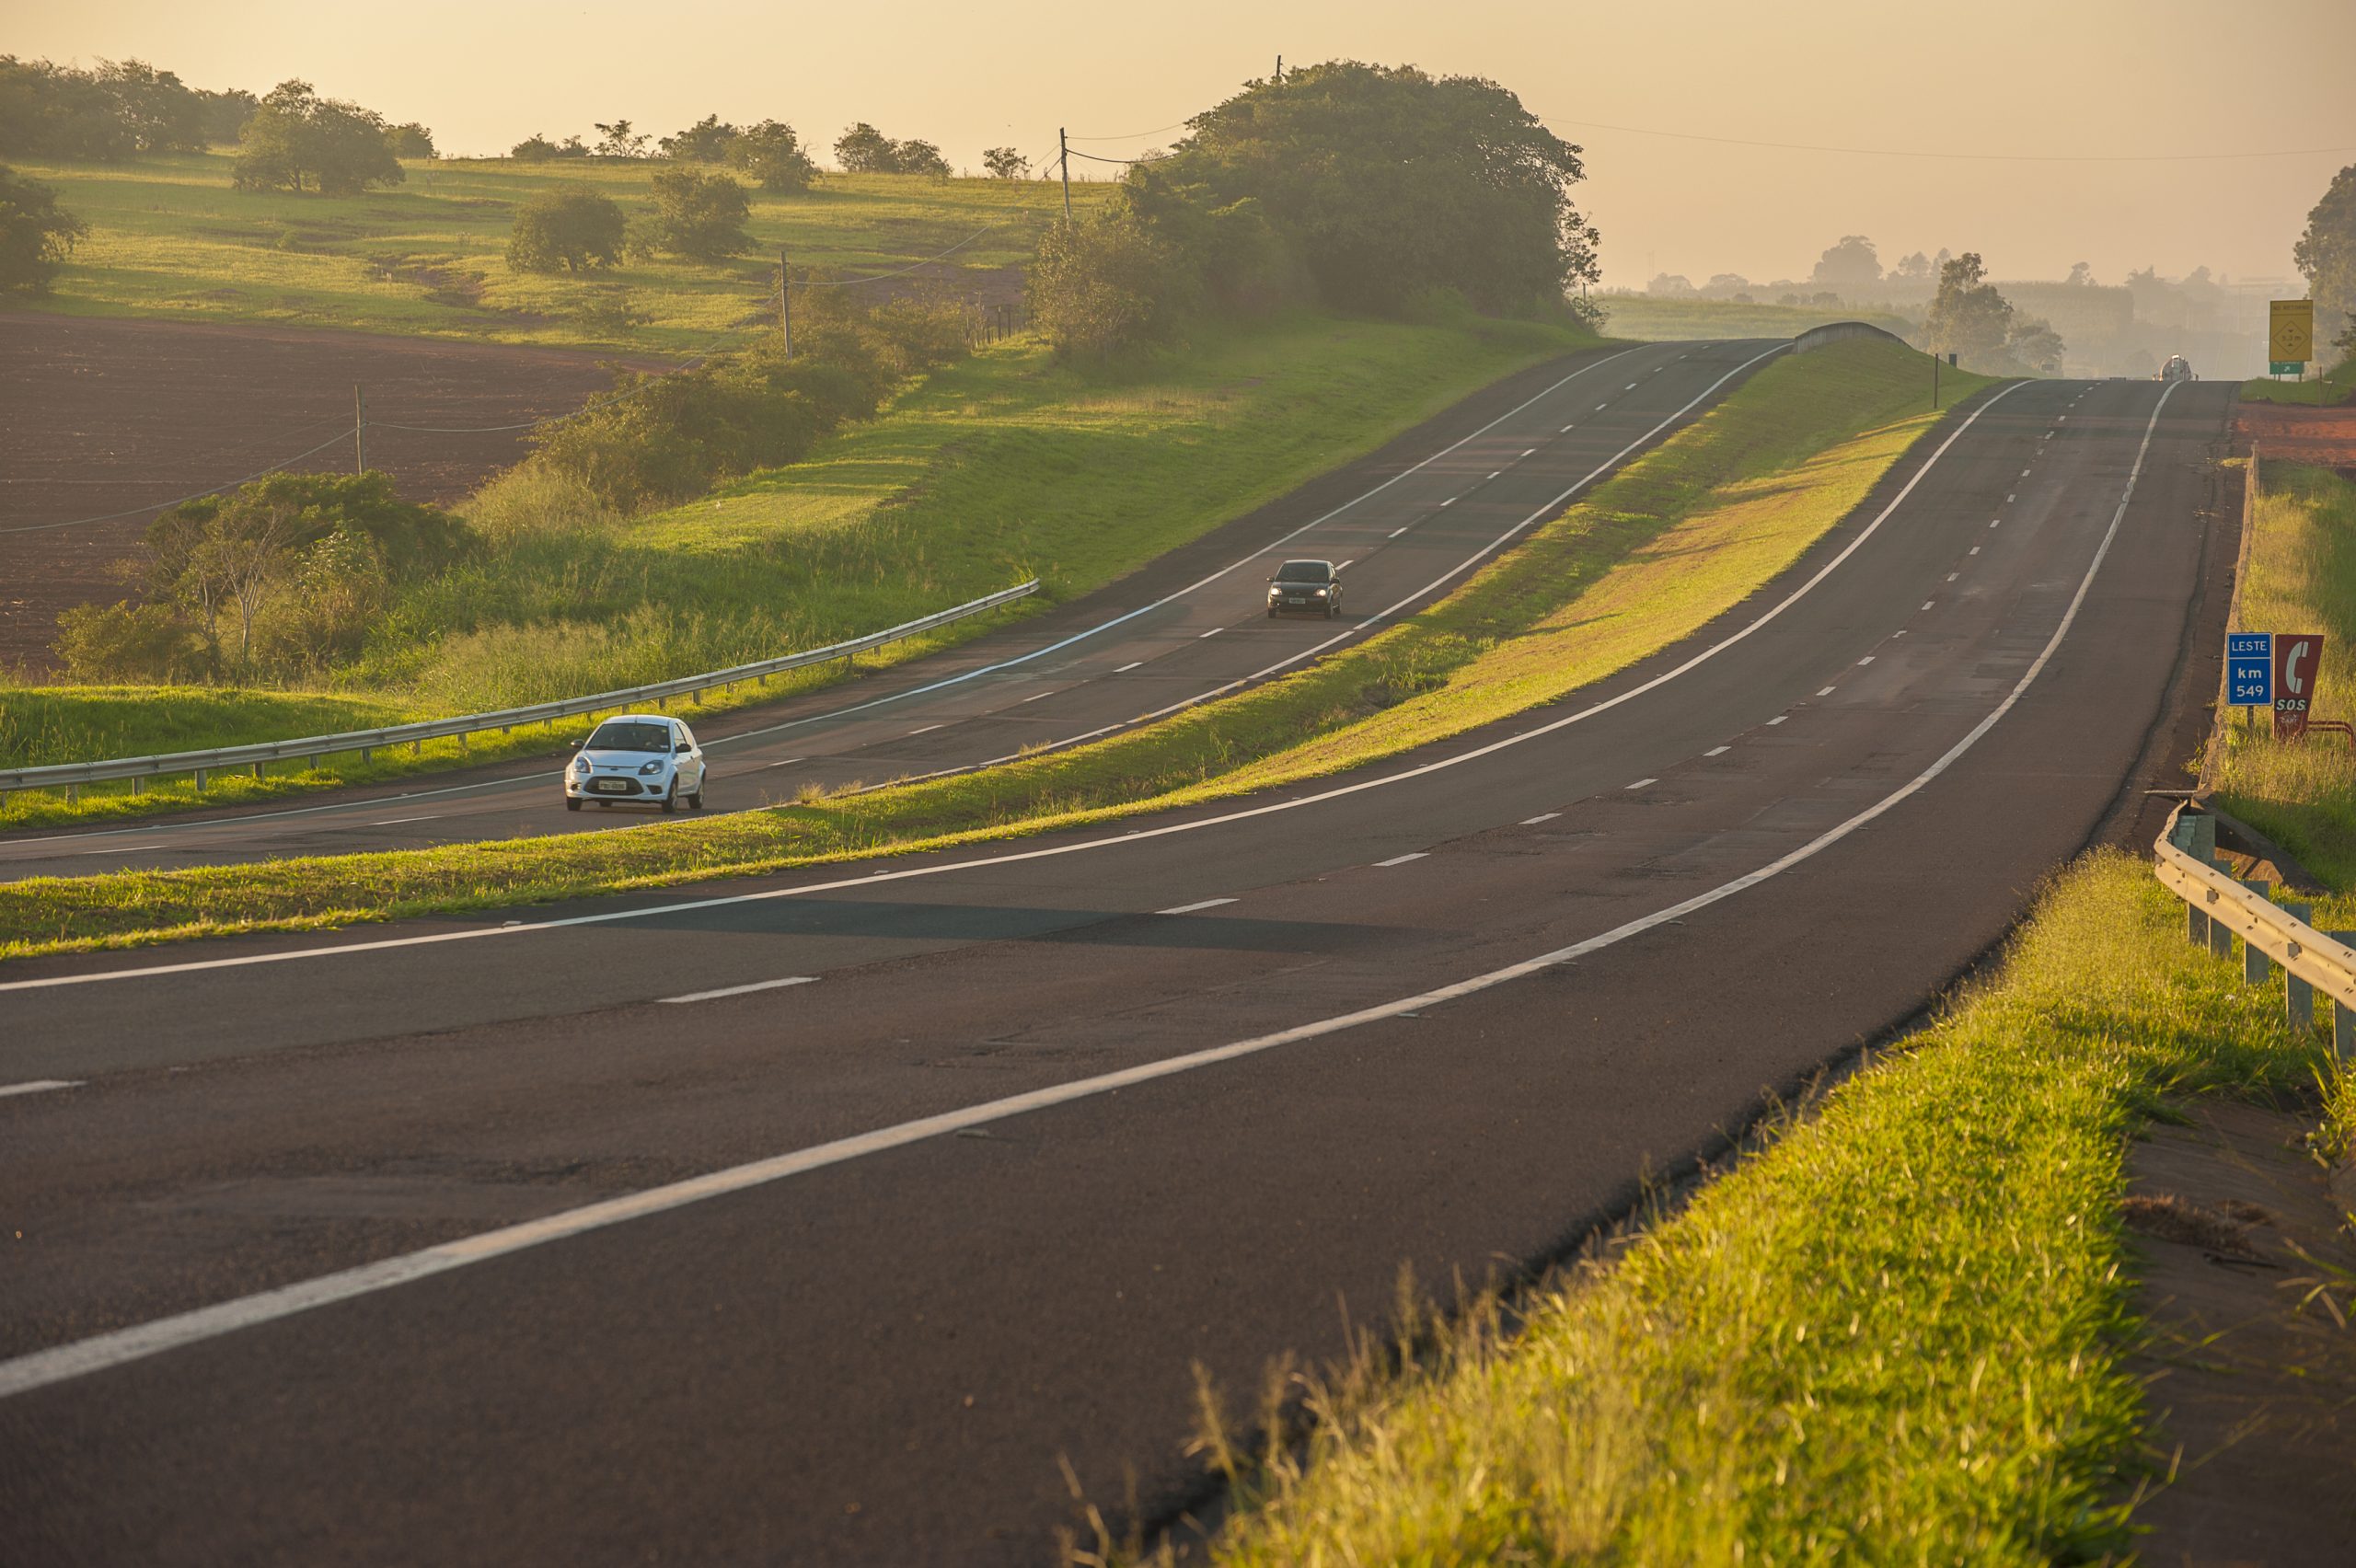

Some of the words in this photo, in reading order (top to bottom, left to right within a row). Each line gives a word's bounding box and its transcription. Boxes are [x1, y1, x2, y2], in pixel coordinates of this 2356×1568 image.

[2232, 640, 2267, 651] LESTE
[2237, 667, 2262, 678] km
[2236, 686, 2264, 698] 549
